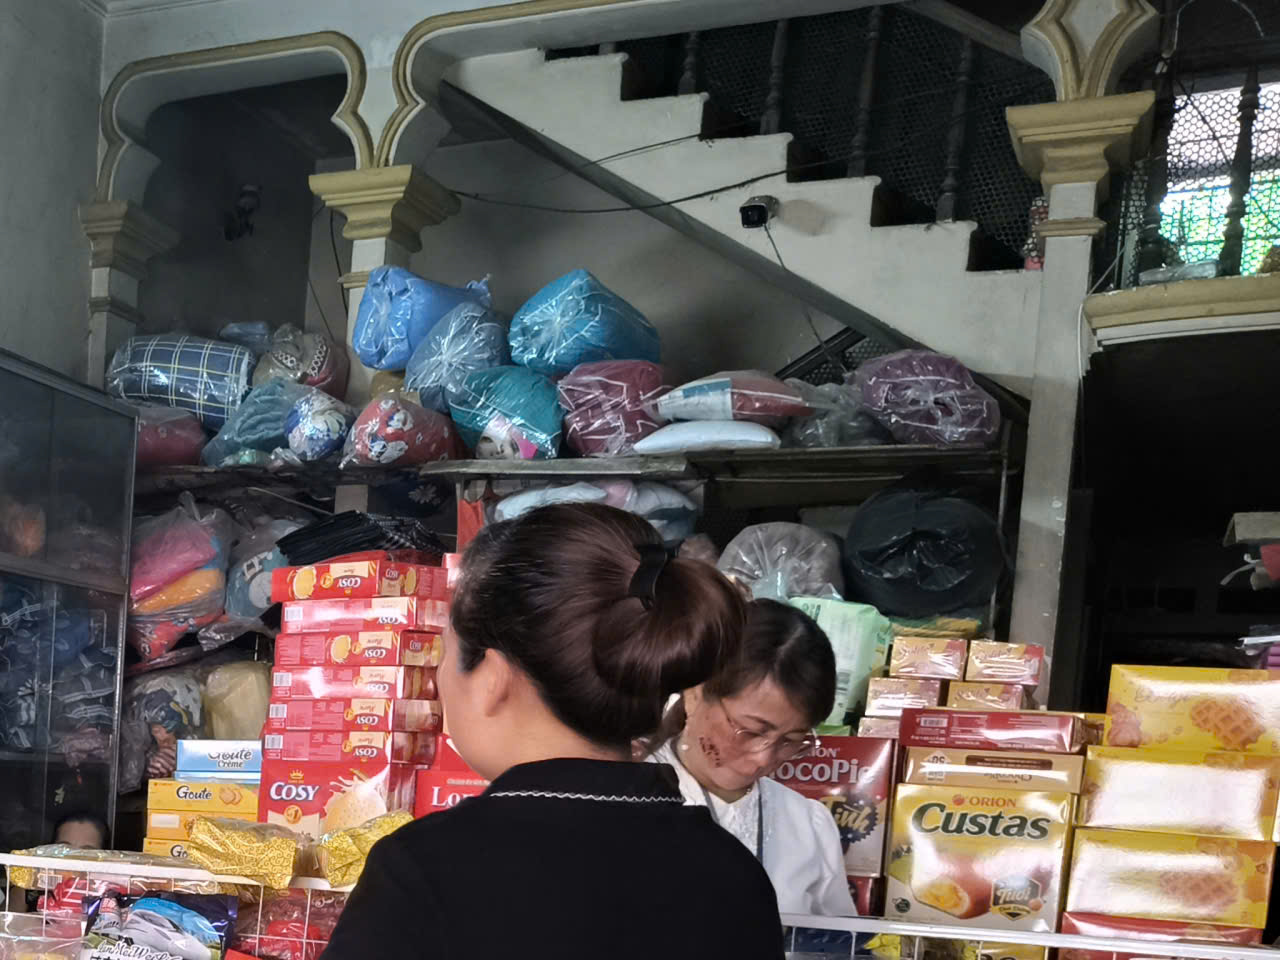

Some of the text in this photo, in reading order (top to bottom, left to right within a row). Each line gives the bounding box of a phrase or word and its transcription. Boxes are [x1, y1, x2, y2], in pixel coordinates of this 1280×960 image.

[365, 648, 387, 658] COSY
[355, 716, 379, 726] COSY
[354, 748, 378, 758] COSY
[269, 782, 321, 801] COSY
[970, 796, 1017, 808] ORION
[912, 801, 1052, 841] Custas
